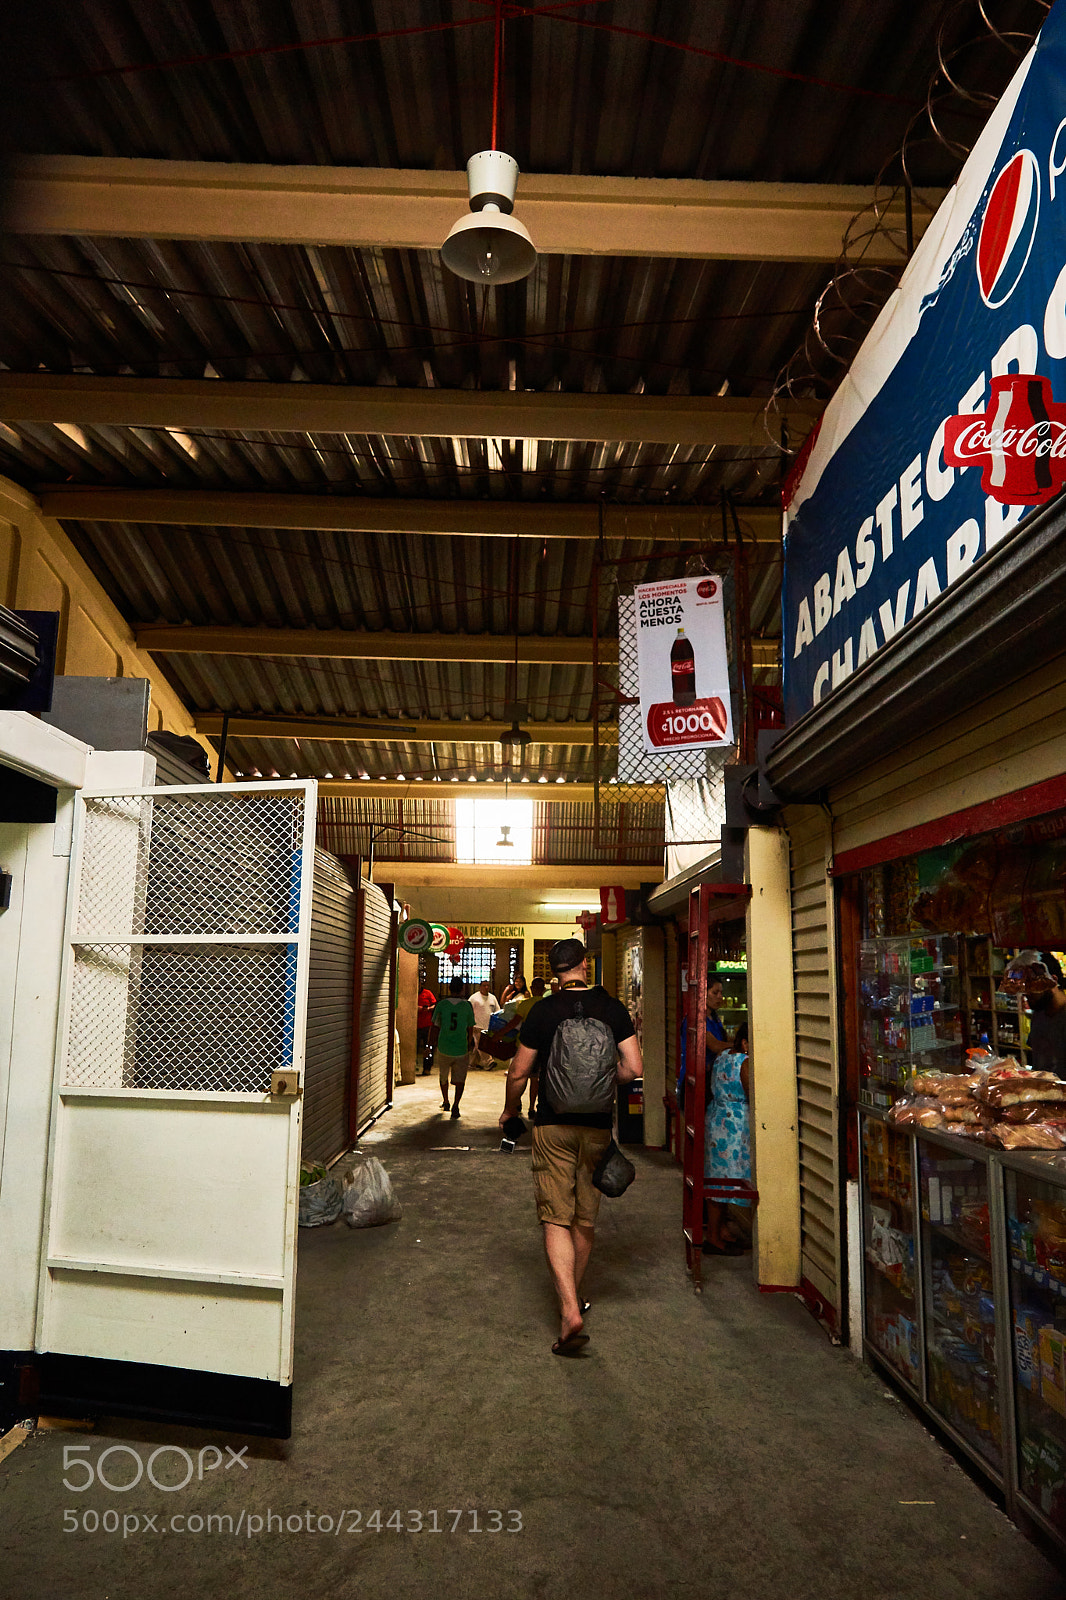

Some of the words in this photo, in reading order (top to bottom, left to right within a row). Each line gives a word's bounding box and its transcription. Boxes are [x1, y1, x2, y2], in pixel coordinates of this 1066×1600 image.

[652, 588, 687, 598] MOMENTOS
[639, 595, 681, 609] AHORA
[639, 605, 684, 618] CUESTA
[640, 614, 682, 628] MENOS
[470, 926, 479, 936] DE
[481, 926, 525, 937] EMERGENCIA
[450, 1012, 458, 1031] 5
